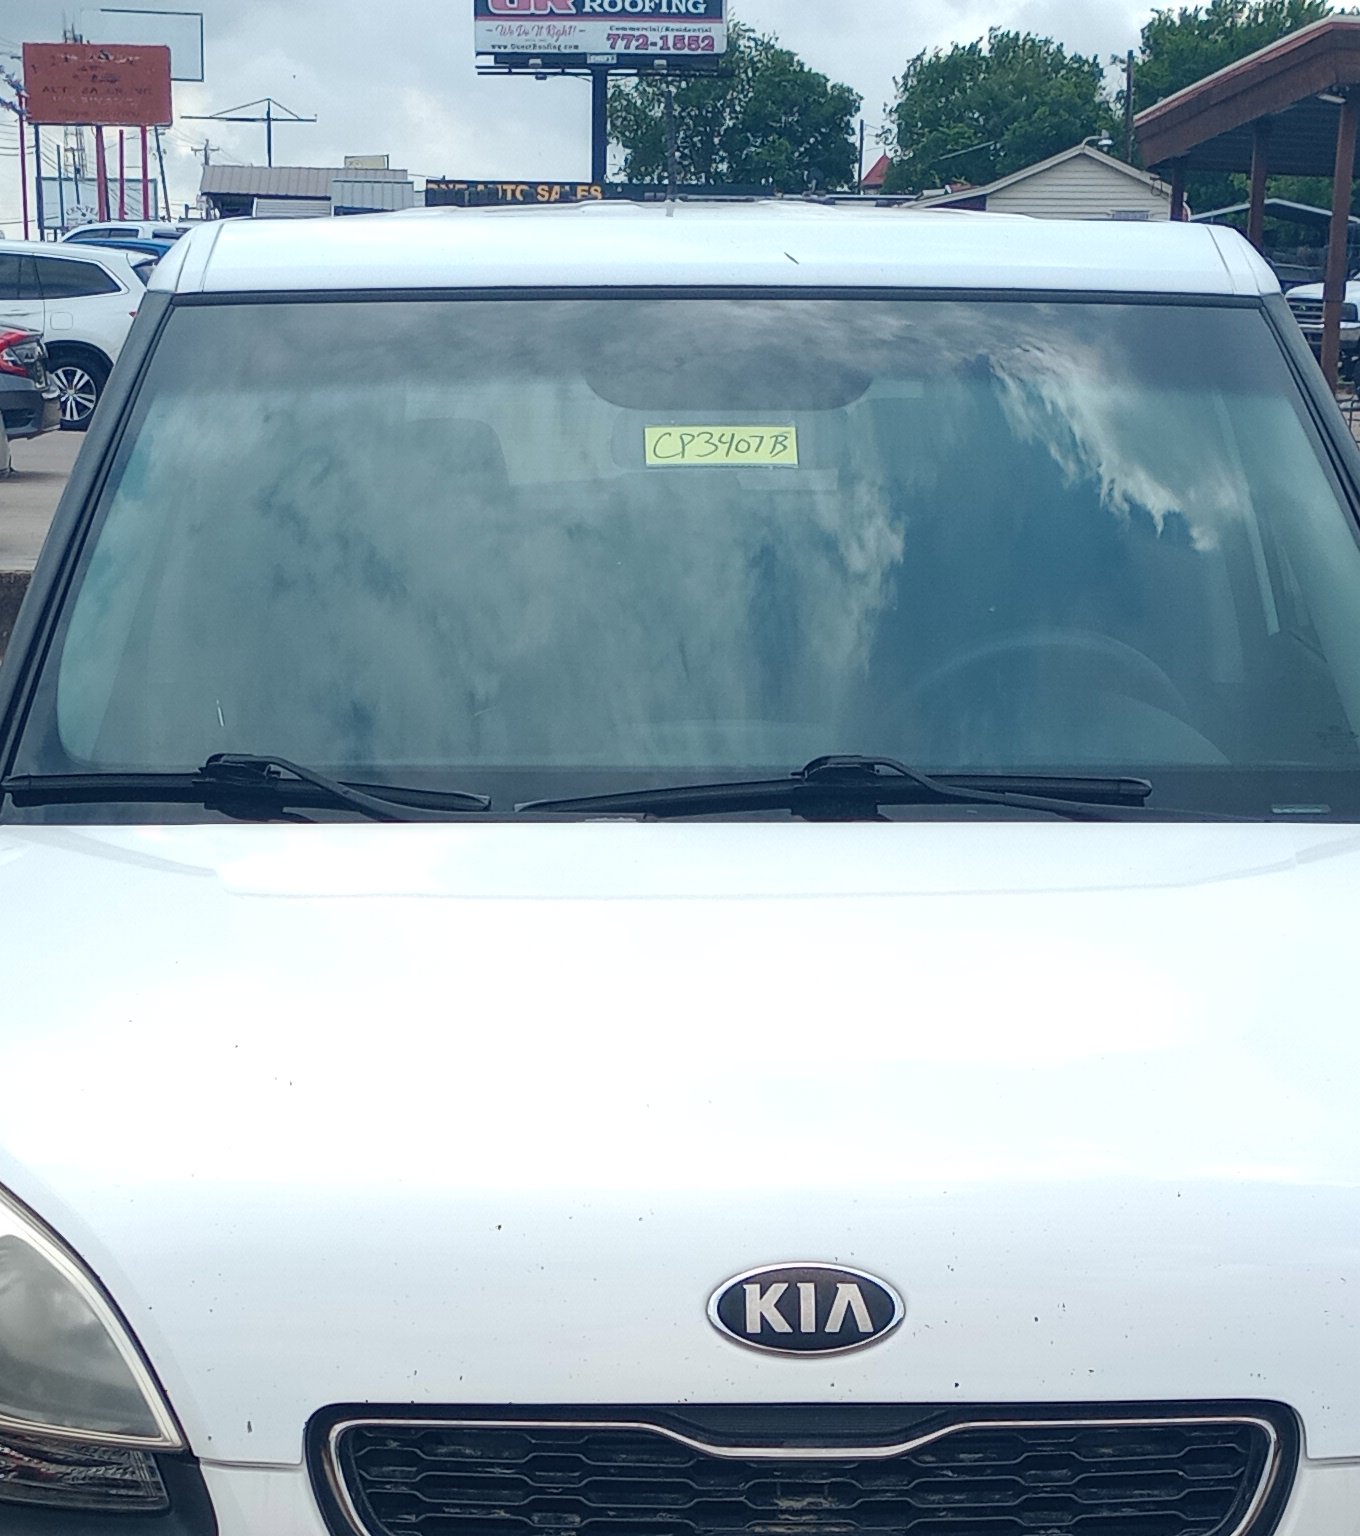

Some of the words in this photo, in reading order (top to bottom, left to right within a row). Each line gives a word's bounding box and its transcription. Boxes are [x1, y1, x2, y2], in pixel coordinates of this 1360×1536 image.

[583, 0, 707, 13] ROOFING
[606, 33, 715, 52] 772-1552
[653, 431, 790, 459] CP3407B
[743, 1282, 874, 1334] KIA
